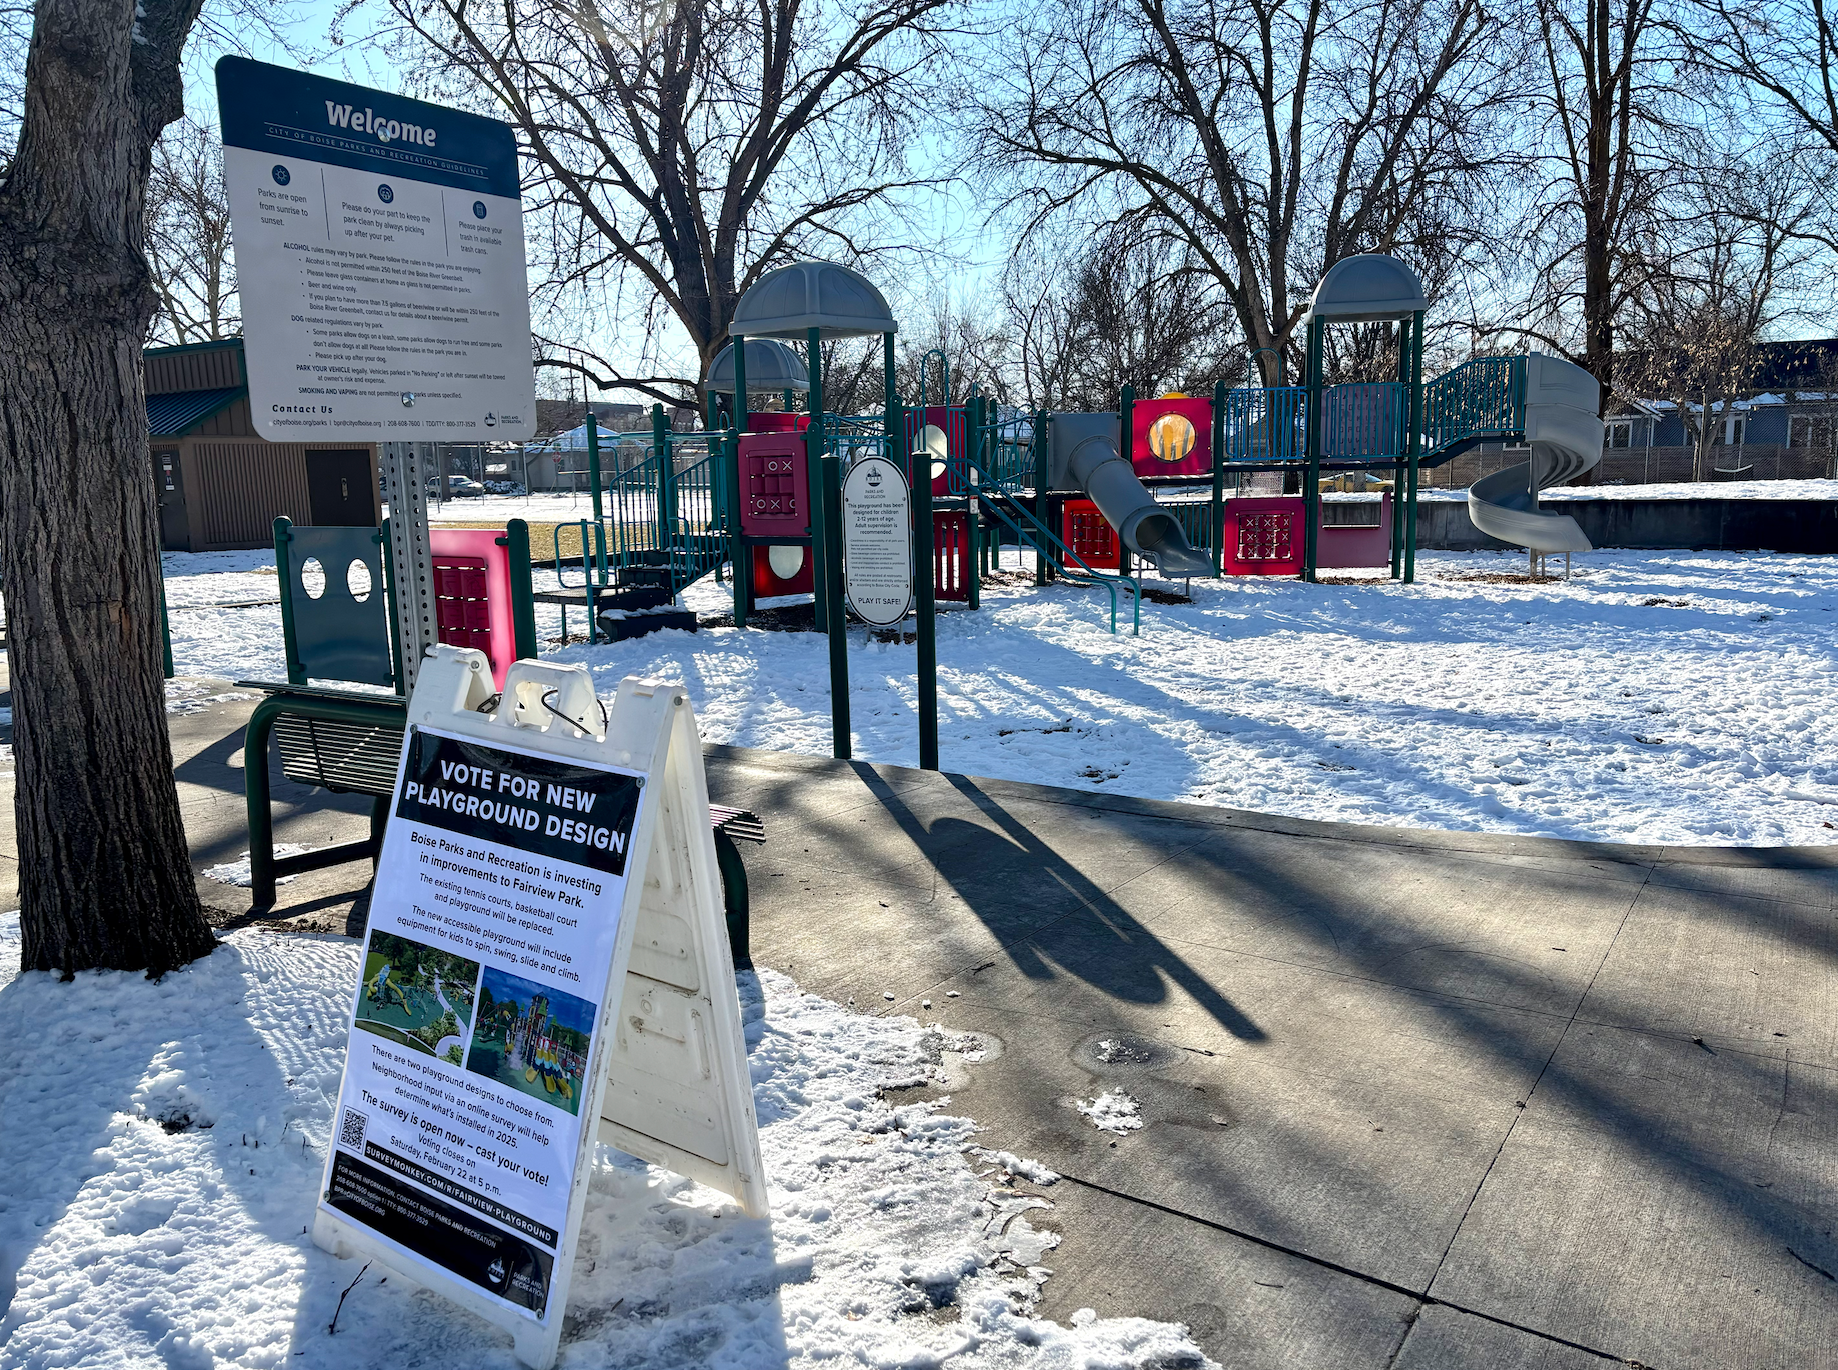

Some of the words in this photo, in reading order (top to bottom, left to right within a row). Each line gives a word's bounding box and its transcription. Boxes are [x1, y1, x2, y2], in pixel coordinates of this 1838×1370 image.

[325, 100, 436, 147] Welcome
[268, 126, 289, 139] CITY
[294, 132, 305, 142] OF
[310, 135, 335, 147] BOISE
[339, 141, 366, 153] PARKS
[369, 147, 386, 158] AND
[389, 151, 438, 167] RECREATION
[441, 162, 484, 176] GUIDELINES
[257, 187, 277, 199] Parks
[277, 192, 289, 201] are
[289, 194, 307, 203] open
[259, 201, 275, 212] from
[276, 205, 300, 216] sunrise
[301, 208, 309, 217] to
[341, 201, 363, 213] Please
[363, 206, 372, 214] do
[372, 208, 386, 216] your
[386, 210, 399, 219] part
[399, 211, 406, 219] to
[406, 212, 421, 223] keep
[421, 215, 431, 224] the
[260, 216, 285, 226] sunset.
[343, 216, 358, 224] park
[357, 217, 375, 227] clean
[375, 220, 383, 230] by
[383, 221, 404, 232] always
[404, 224, 425, 236] picking
[344, 229, 353, 237] up
[353, 229, 368, 238] after
[368, 232, 382, 241] your
[383, 234, 395, 243] pet.
[458, 220, 476, 231] Please
[476, 224, 491, 233] place
[491, 227, 503, 235] your
[459, 233, 473, 242] trash
[473, 234, 479, 242] in
[479, 236, 502, 246] available
[460, 245, 474, 253] trash
[474, 247, 488, 255] cans.
[272, 404, 316, 414] Contact
[320, 405, 333, 414] Us
[298, 386, 325, 395] SMOKING
[337, 388, 358, 396] VAPING
[446, 420, 476, 428] 800-377-3529
[440, 759, 493, 790] VOTE
[498, 773, 540, 801] FOR
[546, 783, 597, 813] NEW
[405, 780, 540, 831] PLAYGROUND
[545, 814, 625, 854] DESIGN
[410, 831, 437, 848] Boise
[438, 838, 465, 856] Parks
[466, 849, 486, 861] and
[487, 852, 540, 877] Recreation
[543, 866, 552, 880] is
[554, 869, 602, 896] investing
[419, 851, 429, 864] in
[430, 854, 498, 884] improvements
[500, 875, 511, 887] to
[513, 877, 556, 900] Fairview
[558, 890, 584, 909] Park.
[420, 872, 433, 885] The
[434, 879, 462, 895] existing
[463, 886, 486, 901] tennis
[487, 895, 513, 910] courts,
[515, 901, 555, 921] basketball
[556, 915, 578, 928] court
[434, 893, 449, 903] and
[448, 897, 491, 916] playground
[492, 910, 506, 921] will
[506, 913, 517, 925] be
[518, 919, 554, 936] replaced.
[397, 916, 436, 935] equipment
[437, 927, 448, 938] for
[448, 931, 464, 944] kids
[465, 937, 473, 947] to
[474, 941, 492, 954] spin,
[493, 948, 518, 963] swing,
[520, 955, 539, 969] slide
[540, 963, 557, 974] and
[557, 968, 581, 983] climb.
[412, 904, 426, 917] The
[427, 911, 443, 922] new
[443, 917, 481, 935] accessible
[482, 929, 526, 949] playground
[527, 943, 541, 954] will
[542, 946, 572, 964] include
[372, 1044, 392, 1060] There
[393, 1055, 406, 1065] are
[407, 1059, 421, 1071] two
[422, 1066, 464, 1088] playground
[465, 1083, 495, 1102] designs
[496, 1095, 505, 1105] to
[505, 1100, 533, 1118] choose
[534, 1111, 554, 1128] from.
[372, 1061, 423, 1089] Neighborhood
[423, 1082, 443, 1098] input
[444, 1092, 455, 1103] via
[456, 1098, 466, 1108] an
[467, 1103, 490, 1119] online
[490, 1113, 516, 1132] survey
[517, 1125, 531, 1137] will
[531, 1130, 549, 1147] help
[362, 1089, 378, 1106] The
[379, 1100, 409, 1123] survey
[410, 1111, 419, 1125] is
[420, 1119, 443, 1137] open
[444, 1131, 466, 1147] now
[475, 1146, 496, 1162] cast
[497, 1155, 521, 1173] your
[523, 1167, 549, 1187] vote!
[394, 1086, 430, 1108] determine
[431, 1103, 455, 1119] what's
[455, 1111, 487, 1134] installed
[487, 1126, 495, 1138] in
[495, 1130, 518, 1149] 2025.
[390, 1135, 422, 1159] Saturday,
[423, 1151, 456, 1176] February
[456, 1167, 467, 1180] 22
[468, 1175, 477, 1184] at
[478, 1177, 484, 1187] 5
[485, 1182, 501, 1196] p.m.
[418, 1133, 441, 1154] Voting
[442, 1146, 465, 1163] closes
[466, 1158, 476, 1169] on
[366, 1146, 551, 1241] SURVEYMONKEY.COM/R/FAIRVIEW-PLAYGROUND
